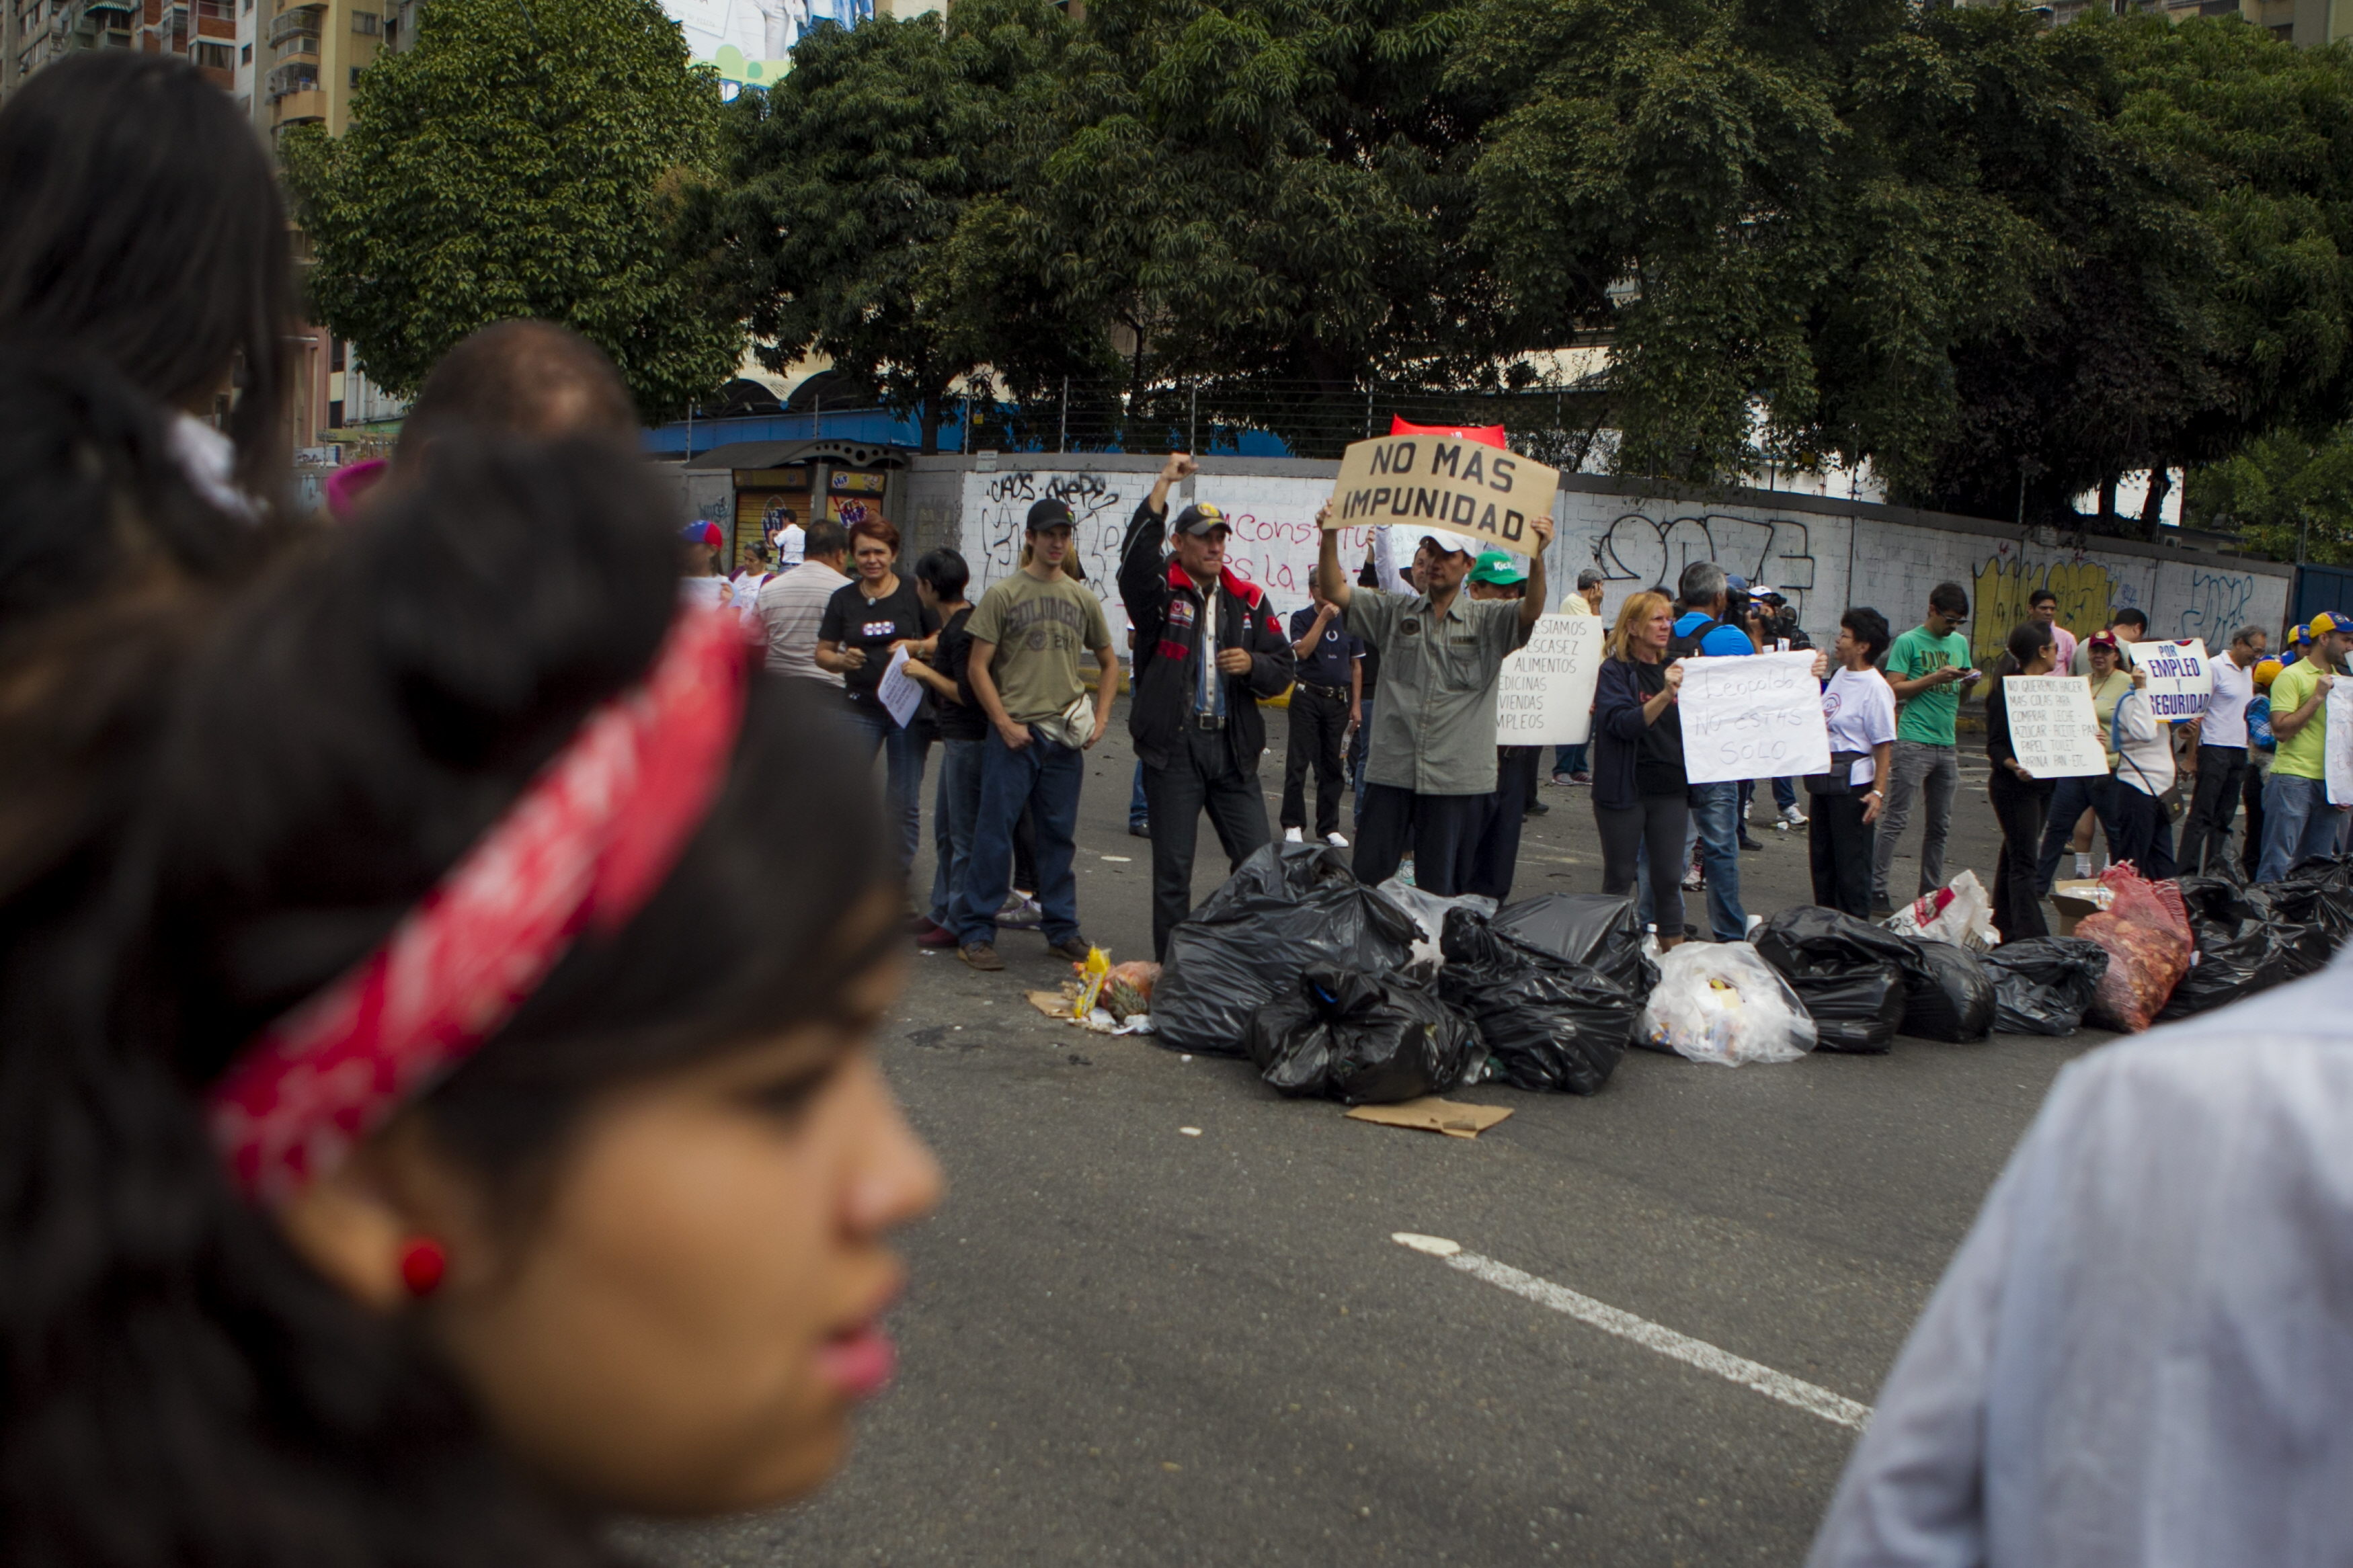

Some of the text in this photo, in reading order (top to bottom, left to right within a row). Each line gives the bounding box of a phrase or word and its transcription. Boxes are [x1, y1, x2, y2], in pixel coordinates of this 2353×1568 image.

[1369, 442, 1516, 493] NO MÁS
[1343, 487, 1524, 542] IMPUNIDAD
[1527, 638, 1579, 655] ESCASEZ
[2158, 645, 2178, 657] POR
[1514, 657, 1577, 673] ALIMENTOS
[2147, 657, 2200, 678] EMPLEO
[1499, 675, 1547, 692] EDICINAS
[1705, 667, 1794, 700] Leopoldo
[2007, 679, 2083, 693] NO QUEREMOS HACER
[2175, 679, 2181, 692] Y
[1499, 694, 1544, 710] VIENDAS
[2009, 696, 2028, 706] MAS
[2030, 695, 2052, 706] COLAS
[1497, 714, 1544, 730] MPLEOS
[1696, 708, 1721, 735] NO
[2011, 710, 2047, 723] COMPRAR
[1720, 741, 1786, 765] SOLO
[2021, 740, 2046, 752] PAPEL
[2021, 755, 2048, 768] HARINA
